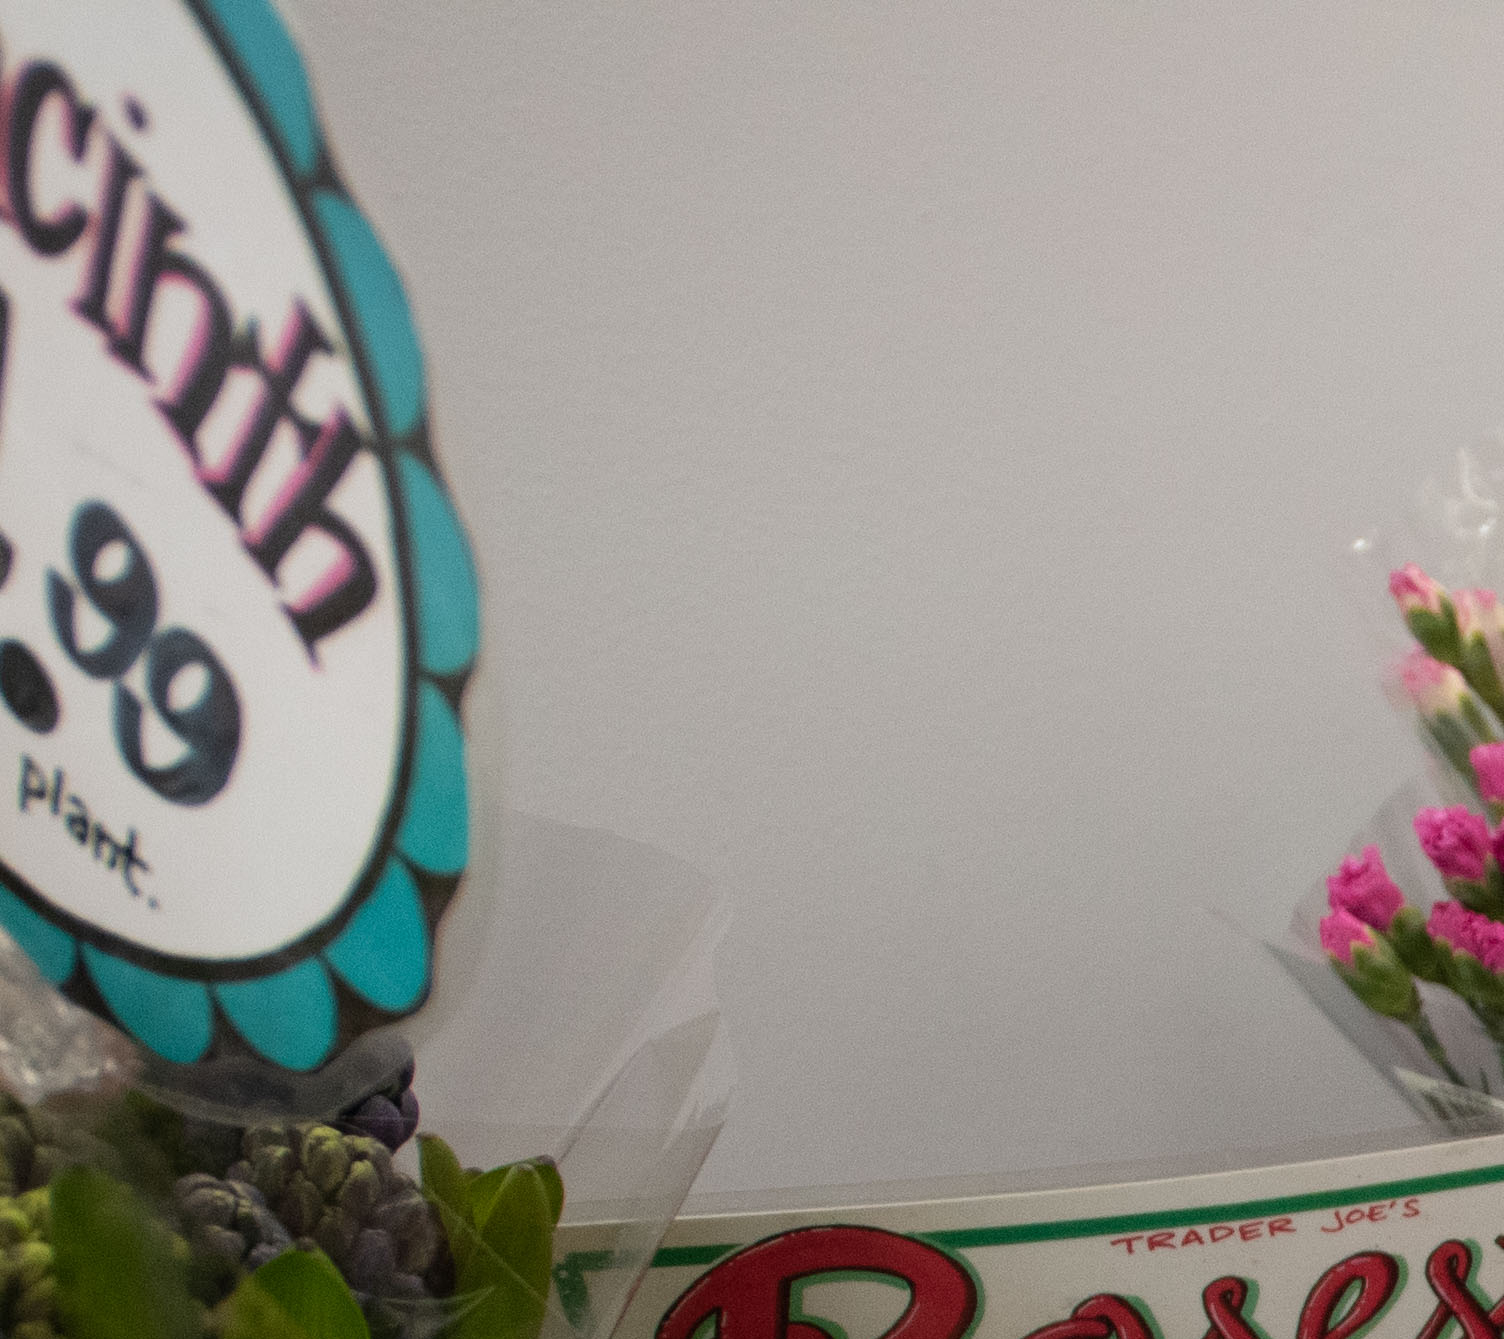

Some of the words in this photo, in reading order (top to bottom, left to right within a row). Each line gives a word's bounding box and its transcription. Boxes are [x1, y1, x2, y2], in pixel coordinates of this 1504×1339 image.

[18, 750, 162, 910] plant.
[1109, 1213, 1297, 1259] TRADER
[1320, 1196, 1424, 1238] JOE'S
